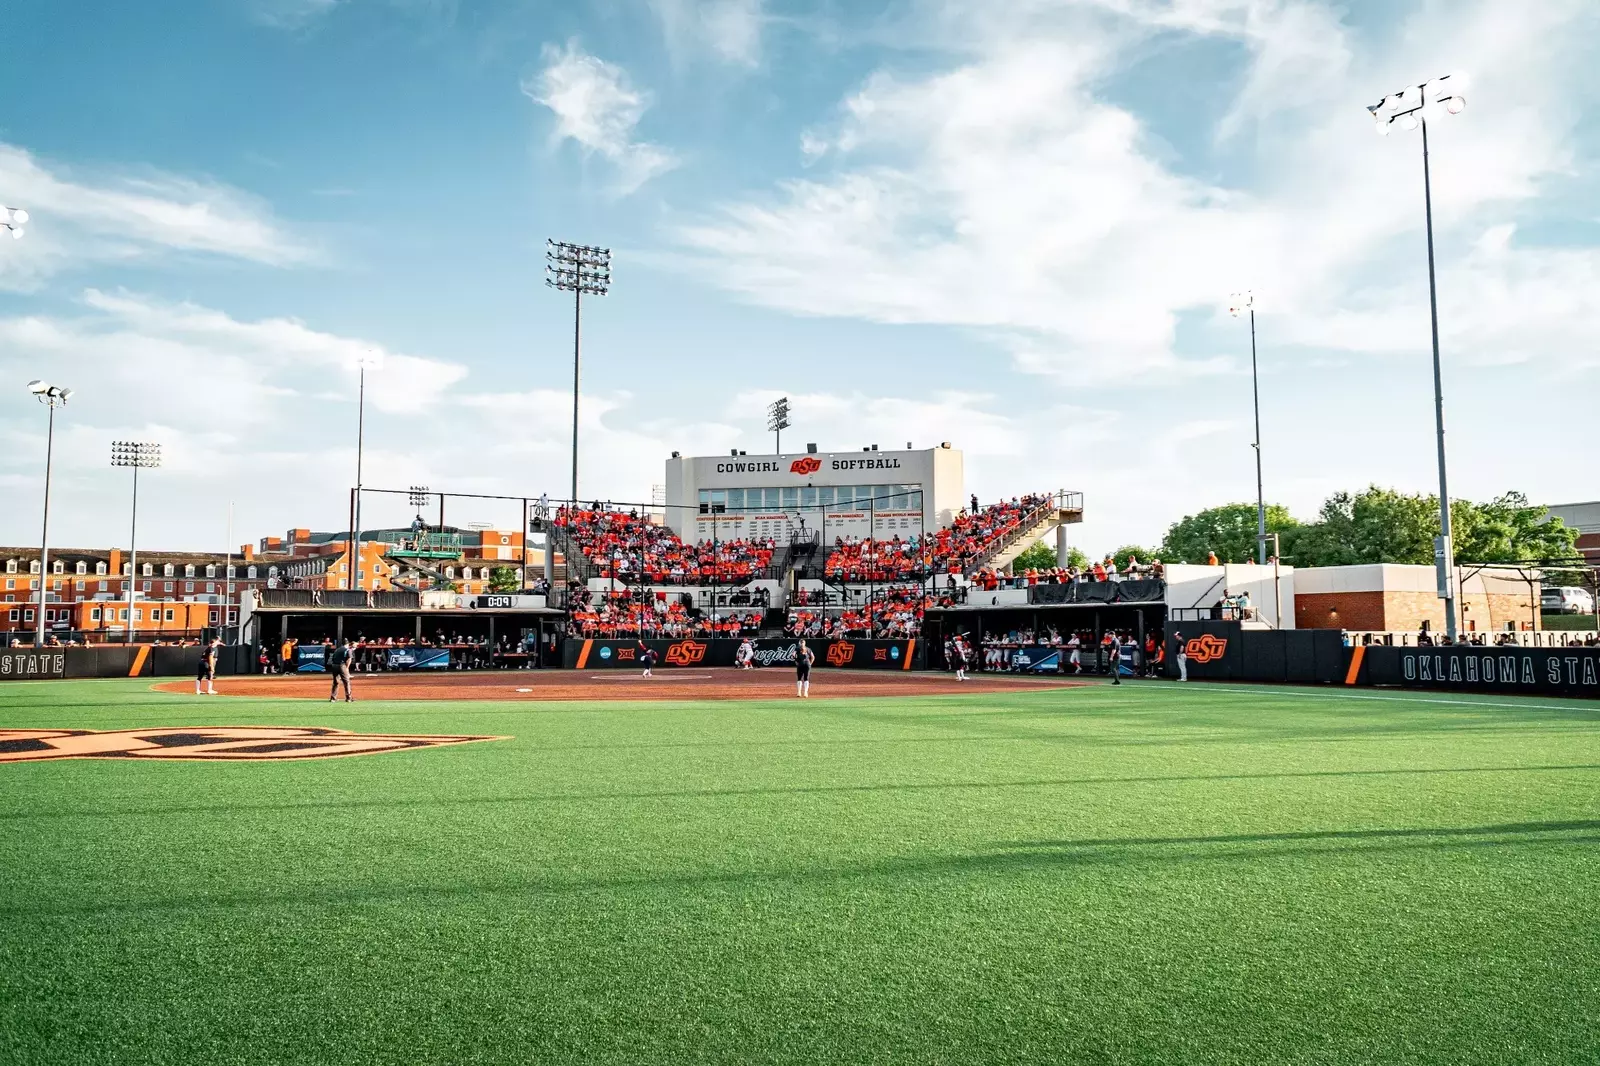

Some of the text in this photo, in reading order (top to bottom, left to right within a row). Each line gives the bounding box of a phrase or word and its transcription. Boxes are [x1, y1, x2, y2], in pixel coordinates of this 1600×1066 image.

[716, 456, 901, 475] COWGIRL OSU SOFTBALL
[488, 597, 509, 606] 0:09
[665, 640, 707, 666] OSU
[826, 640, 855, 666] OSU
[1185, 634, 1228, 663] OSU
[1, 654, 63, 674] STATE
[1404, 655, 1600, 685] OKLAHOMA STA
